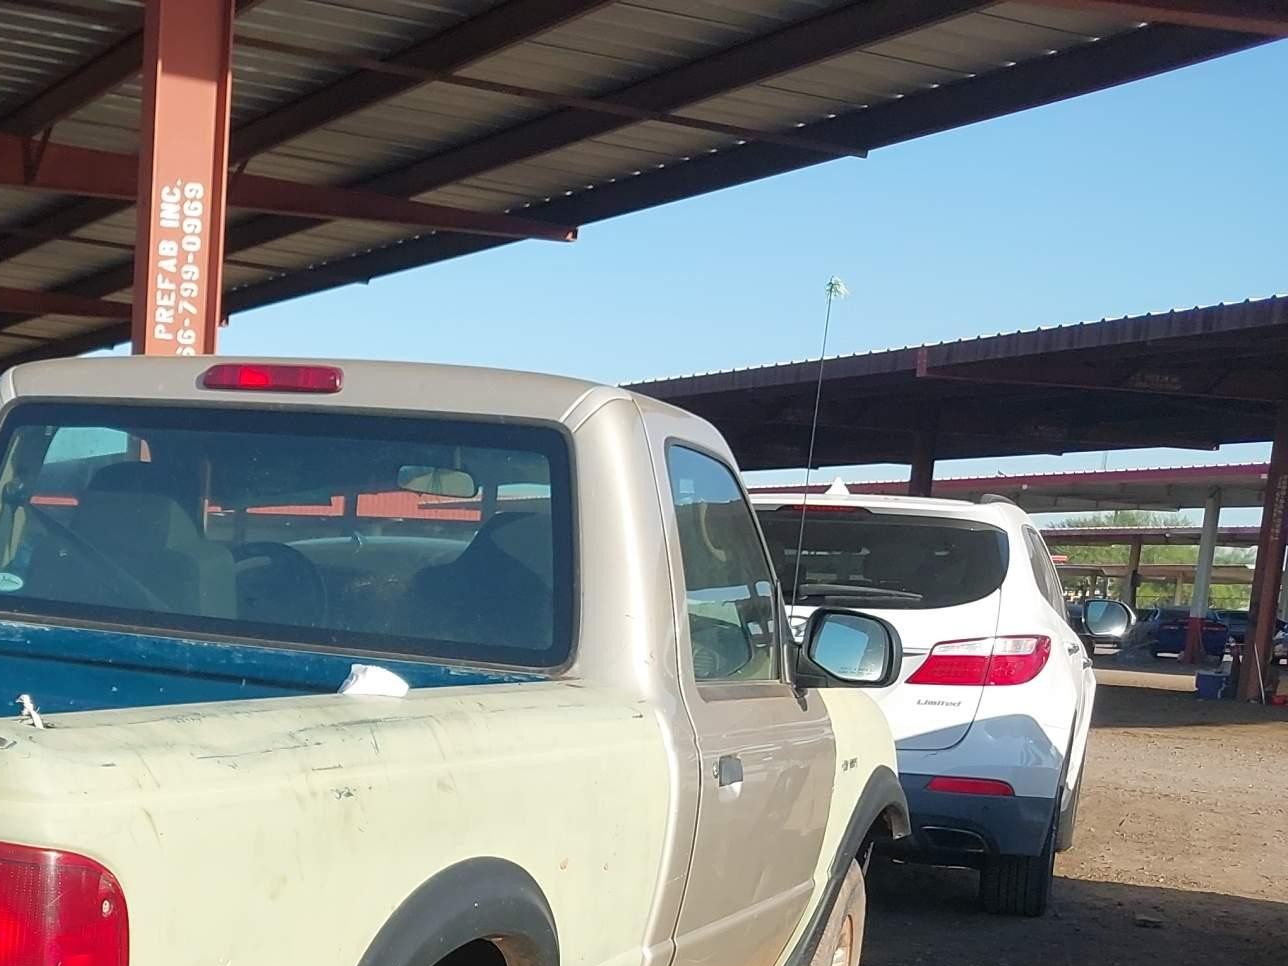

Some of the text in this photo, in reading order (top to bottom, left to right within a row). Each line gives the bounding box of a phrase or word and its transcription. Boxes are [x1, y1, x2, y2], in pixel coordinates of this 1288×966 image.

[154, 178, 183, 340] PREFAB INC.
[916, 698, 962, 707] Limited
